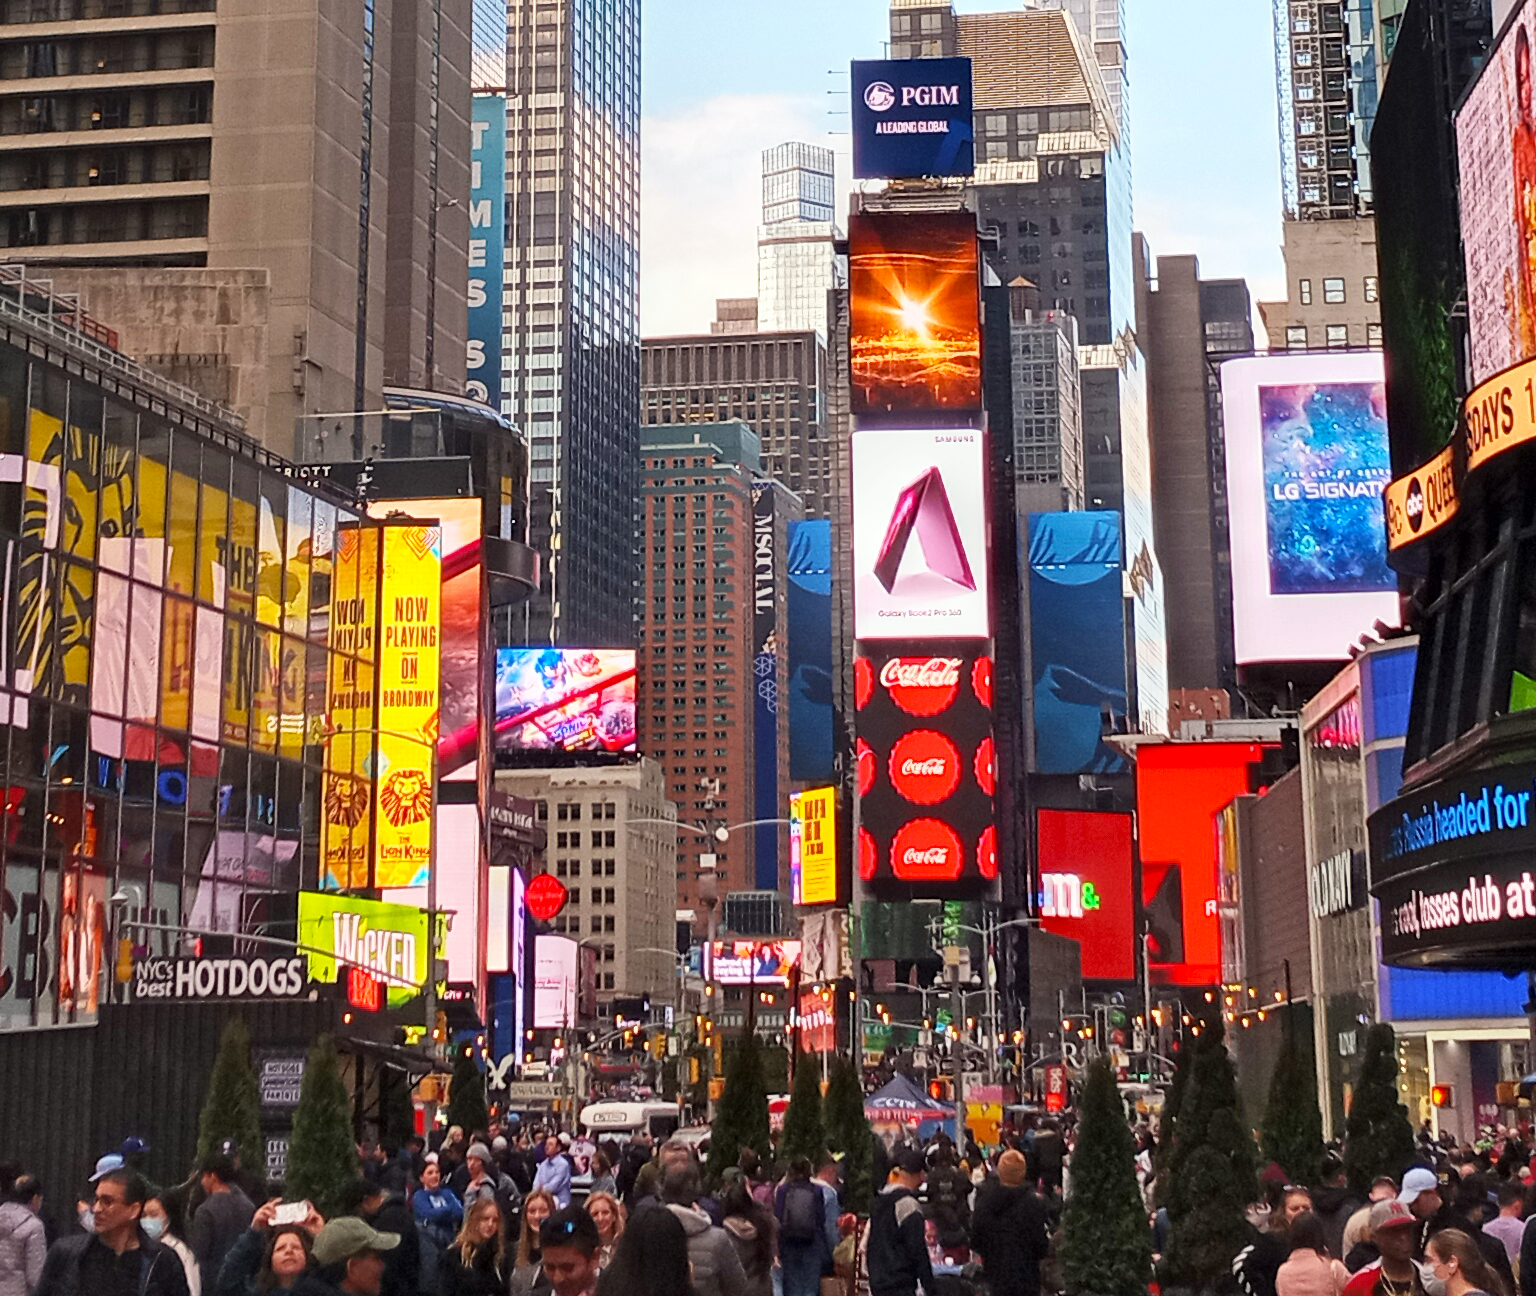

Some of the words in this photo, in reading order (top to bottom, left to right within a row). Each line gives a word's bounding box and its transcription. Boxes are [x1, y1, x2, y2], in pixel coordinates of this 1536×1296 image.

[901, 85, 959, 106] PGIM
[876, 123, 882, 134] A
[883, 121, 917, 134] LEADING
[918, 120, 949, 133] GLOBAL
[935, 435, 975, 443] SAMSUNG
[1273, 483, 1300, 501] LG
[1406, 492, 1424, 517] abc
[395, 597, 428, 624] NOW
[878, 609, 907, 618] Galaxy
[934, 608, 947, 616] Pro
[385, 625, 437, 649] PLAYING
[401, 657, 418, 680] ON
[383, 689, 435, 709] BROADWAY
[1433, 788, 1492, 844] headed
[1494, 785, 1530, 830] for
[1420, 889, 1460, 931] losses
[1461, 874, 1501, 924] club
[1506, 872, 1536, 920] at
[136, 959, 174, 981] NYC's
[135, 977, 174, 998] best
